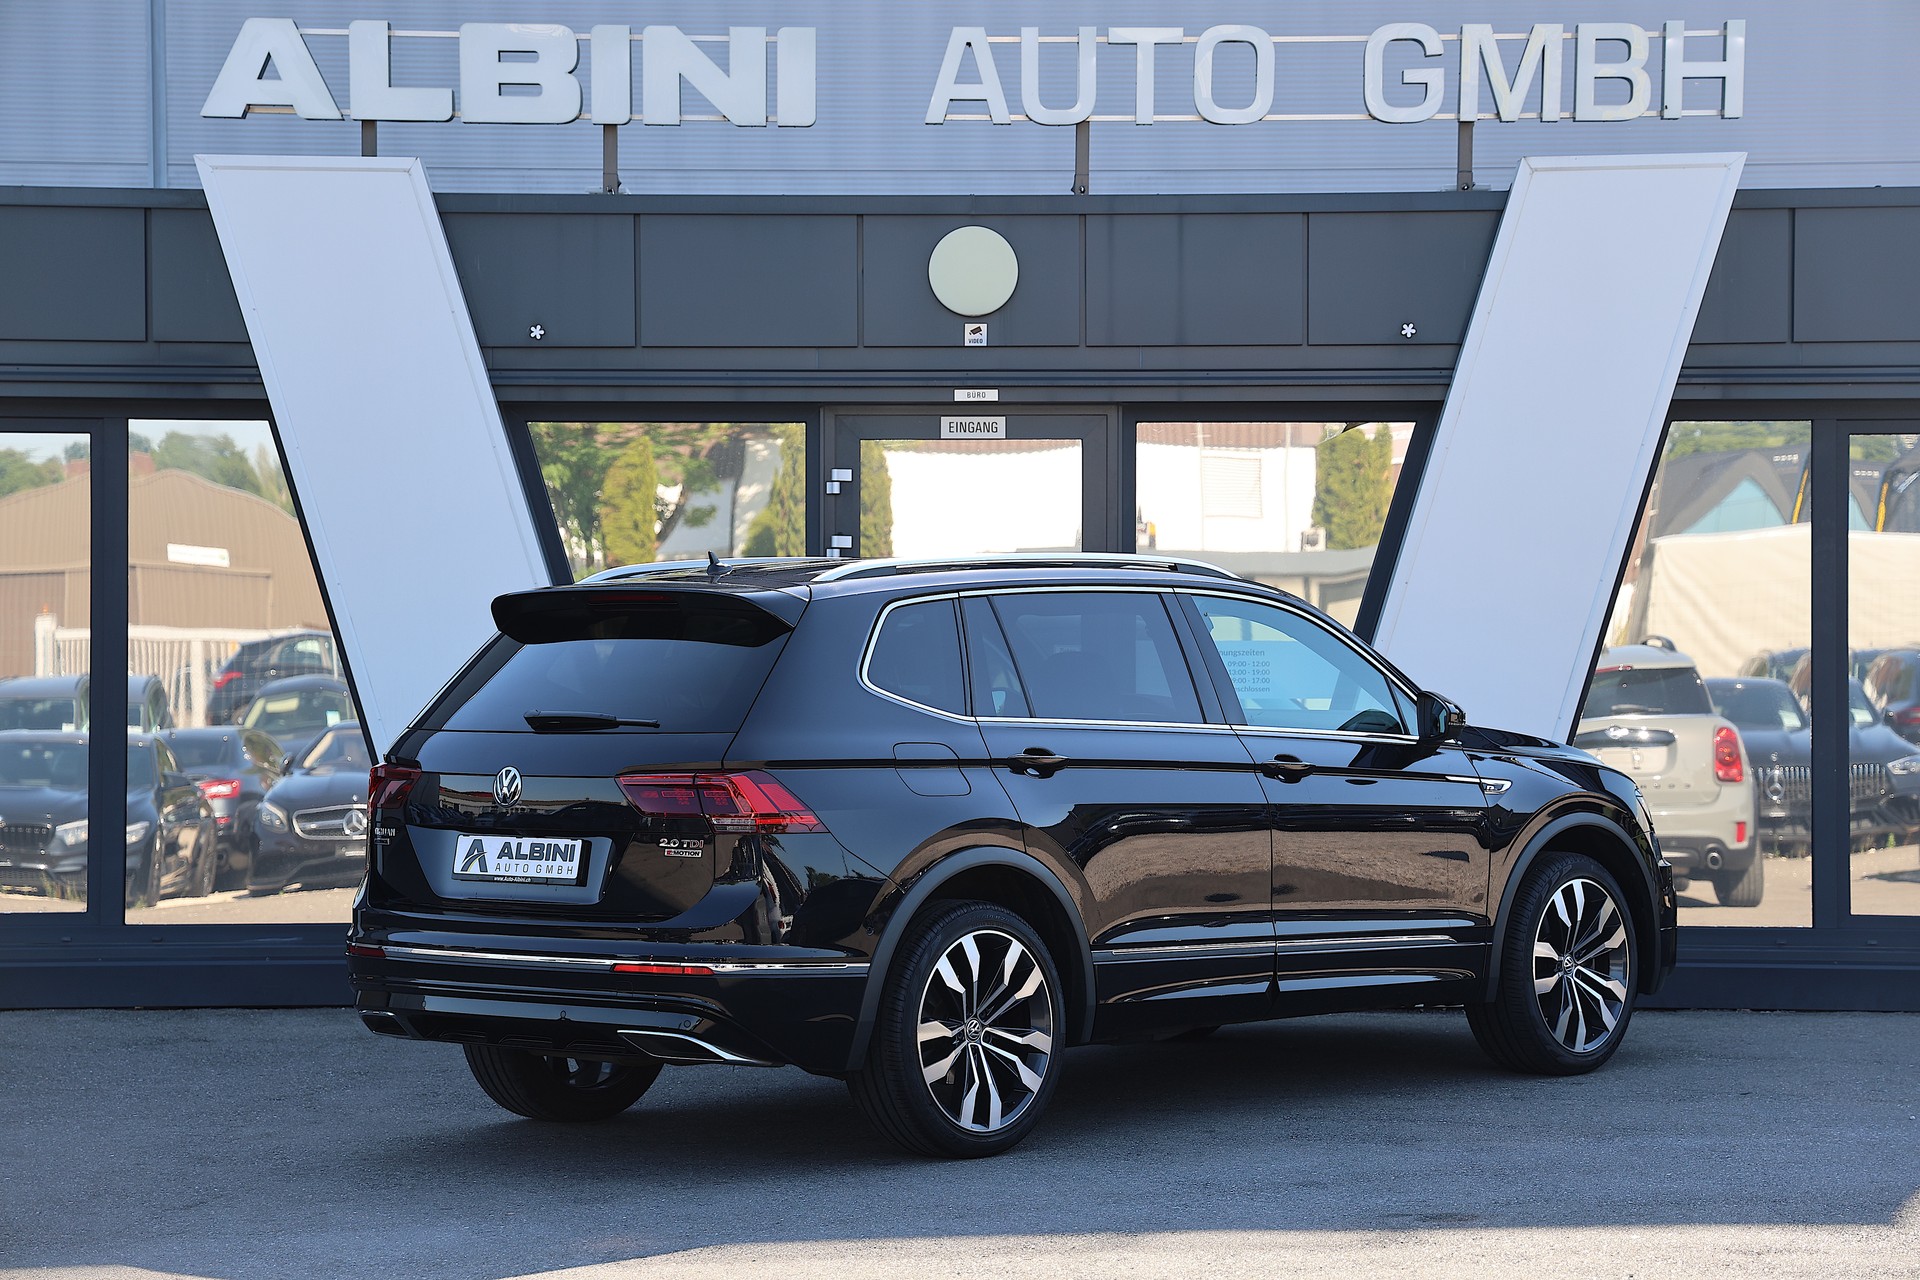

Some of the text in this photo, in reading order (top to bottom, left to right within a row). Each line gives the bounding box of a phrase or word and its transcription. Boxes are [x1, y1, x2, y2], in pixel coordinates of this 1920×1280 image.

[200, 18, 1746, 128] ALBINI AUTO GMBH
[966, 390, 987, 399] BÜRO
[948, 421, 999, 433] EINGANG
[1219, 649, 1265, 657] nungszeiten
[658, 838, 704, 848] 2.0 TDI
[496, 841, 576, 863] ALBINI
[494, 862, 574, 875] AUTO GMBH
